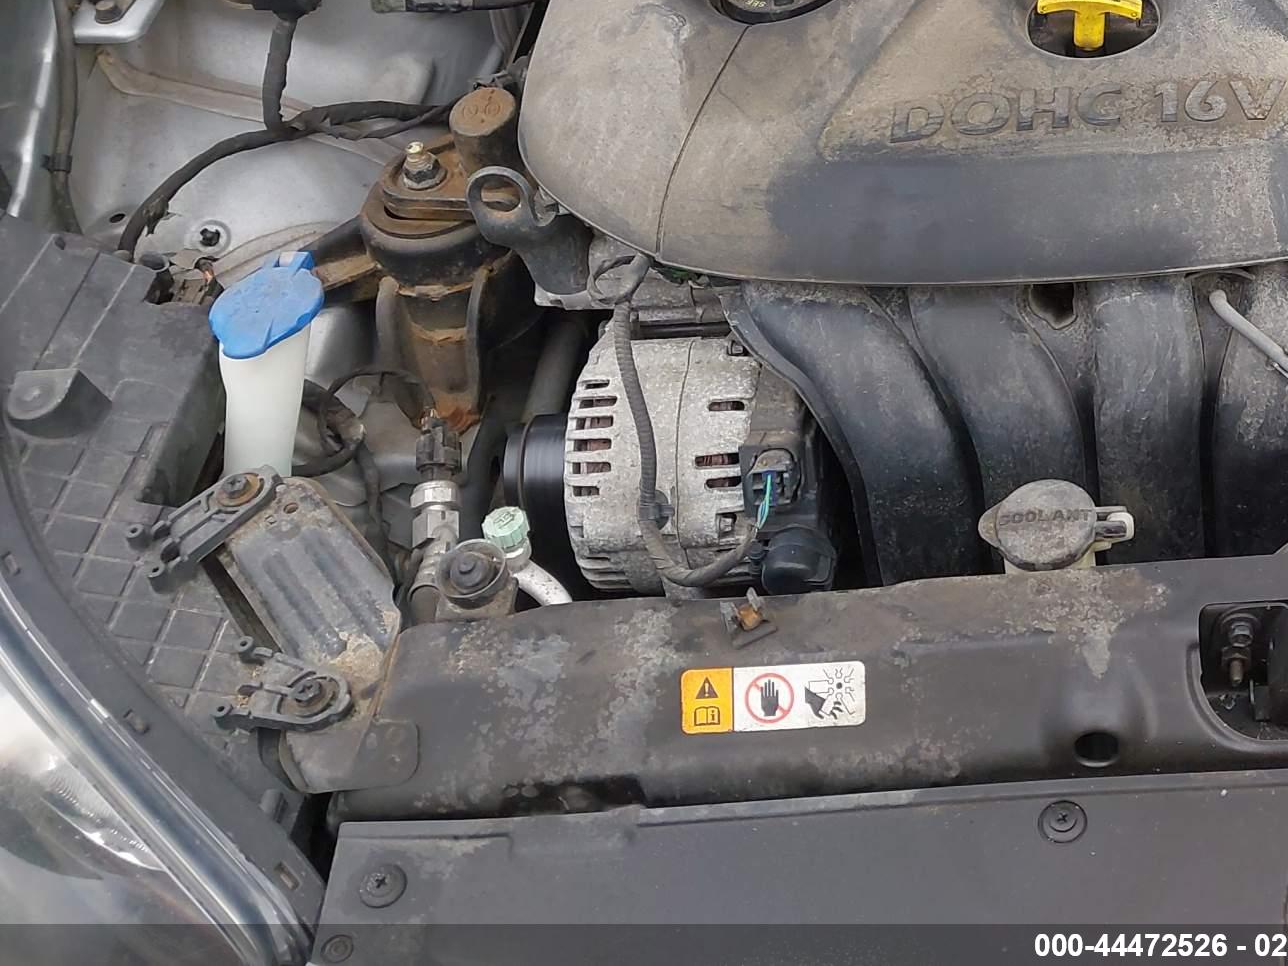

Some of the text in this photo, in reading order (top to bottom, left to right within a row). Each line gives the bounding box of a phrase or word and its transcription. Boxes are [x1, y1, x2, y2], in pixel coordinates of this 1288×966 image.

[889, 79, 1286, 143] DOHC 16V
[1000, 509, 1093, 526] COOLANT
